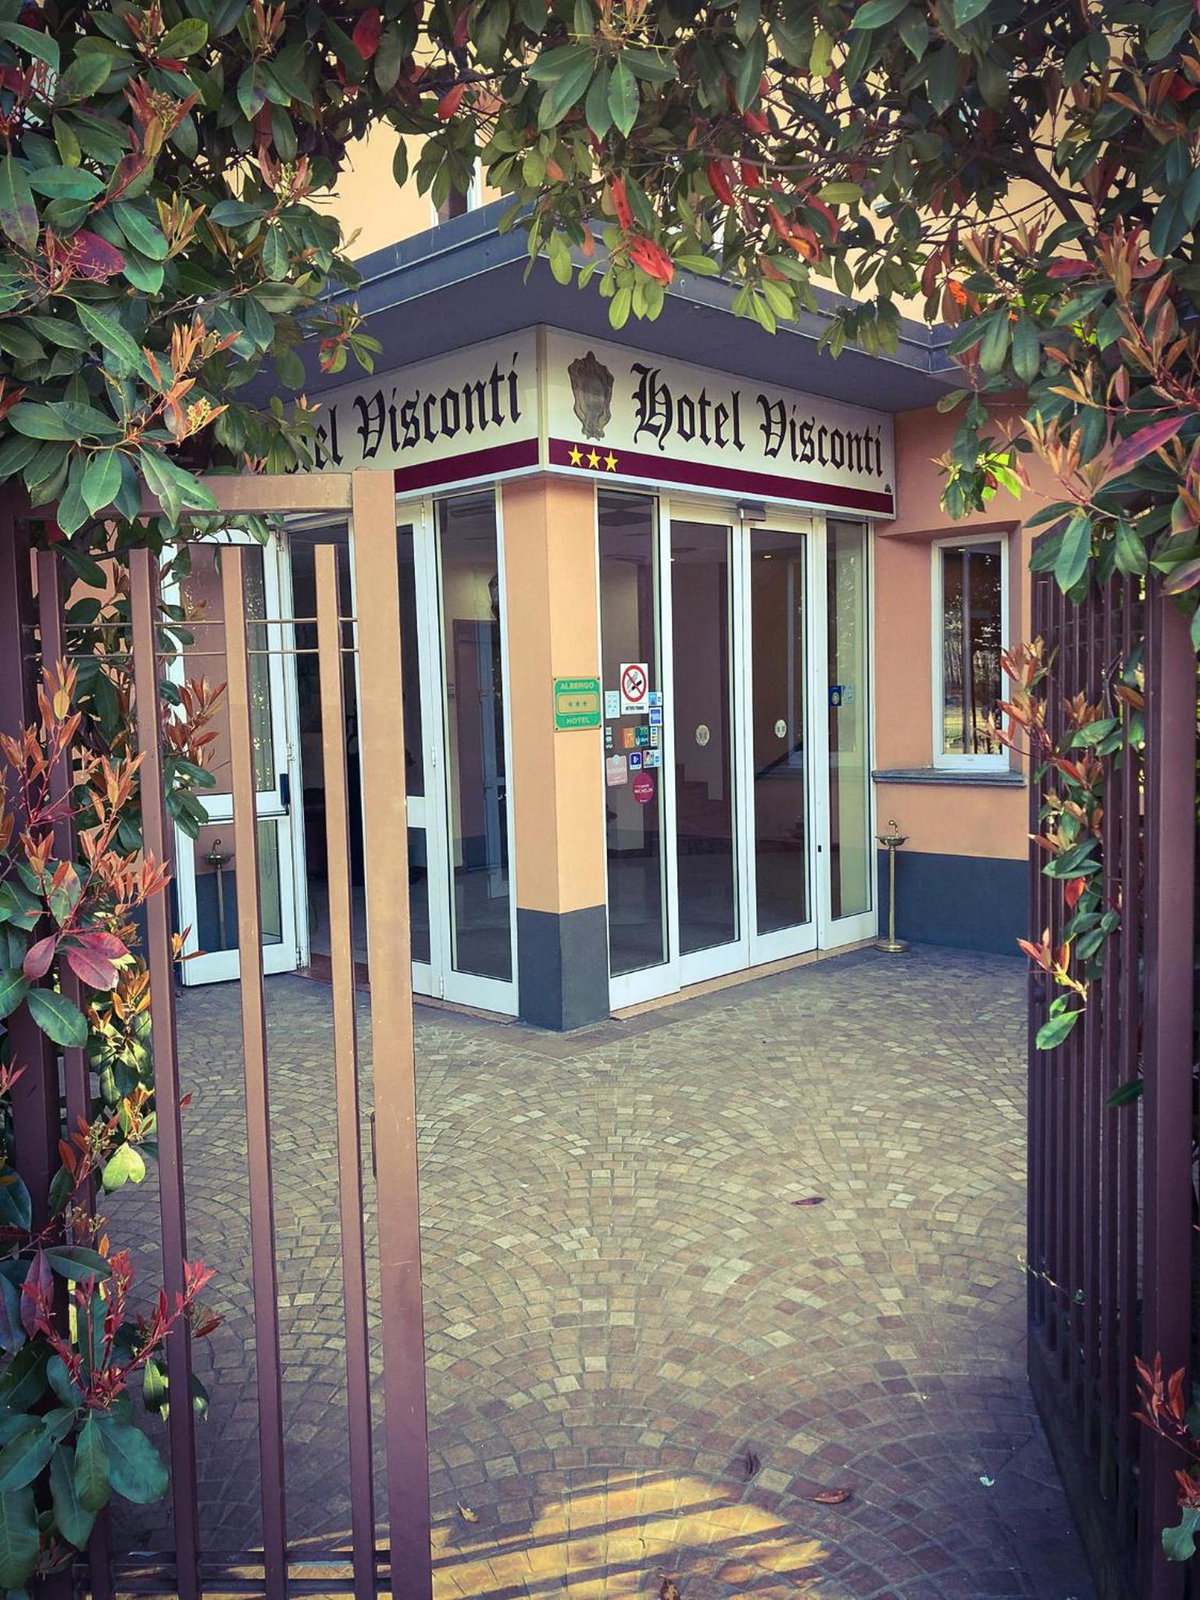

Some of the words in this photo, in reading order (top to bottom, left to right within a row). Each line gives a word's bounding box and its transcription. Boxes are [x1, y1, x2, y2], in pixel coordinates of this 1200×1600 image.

[353, 352, 521, 460] Visconti
[630, 362, 746, 452] Hotel
[756, 394, 884, 477] Visconti
[560, 682, 595, 690] ALBERGO
[566, 717, 591, 725] HOTEL
